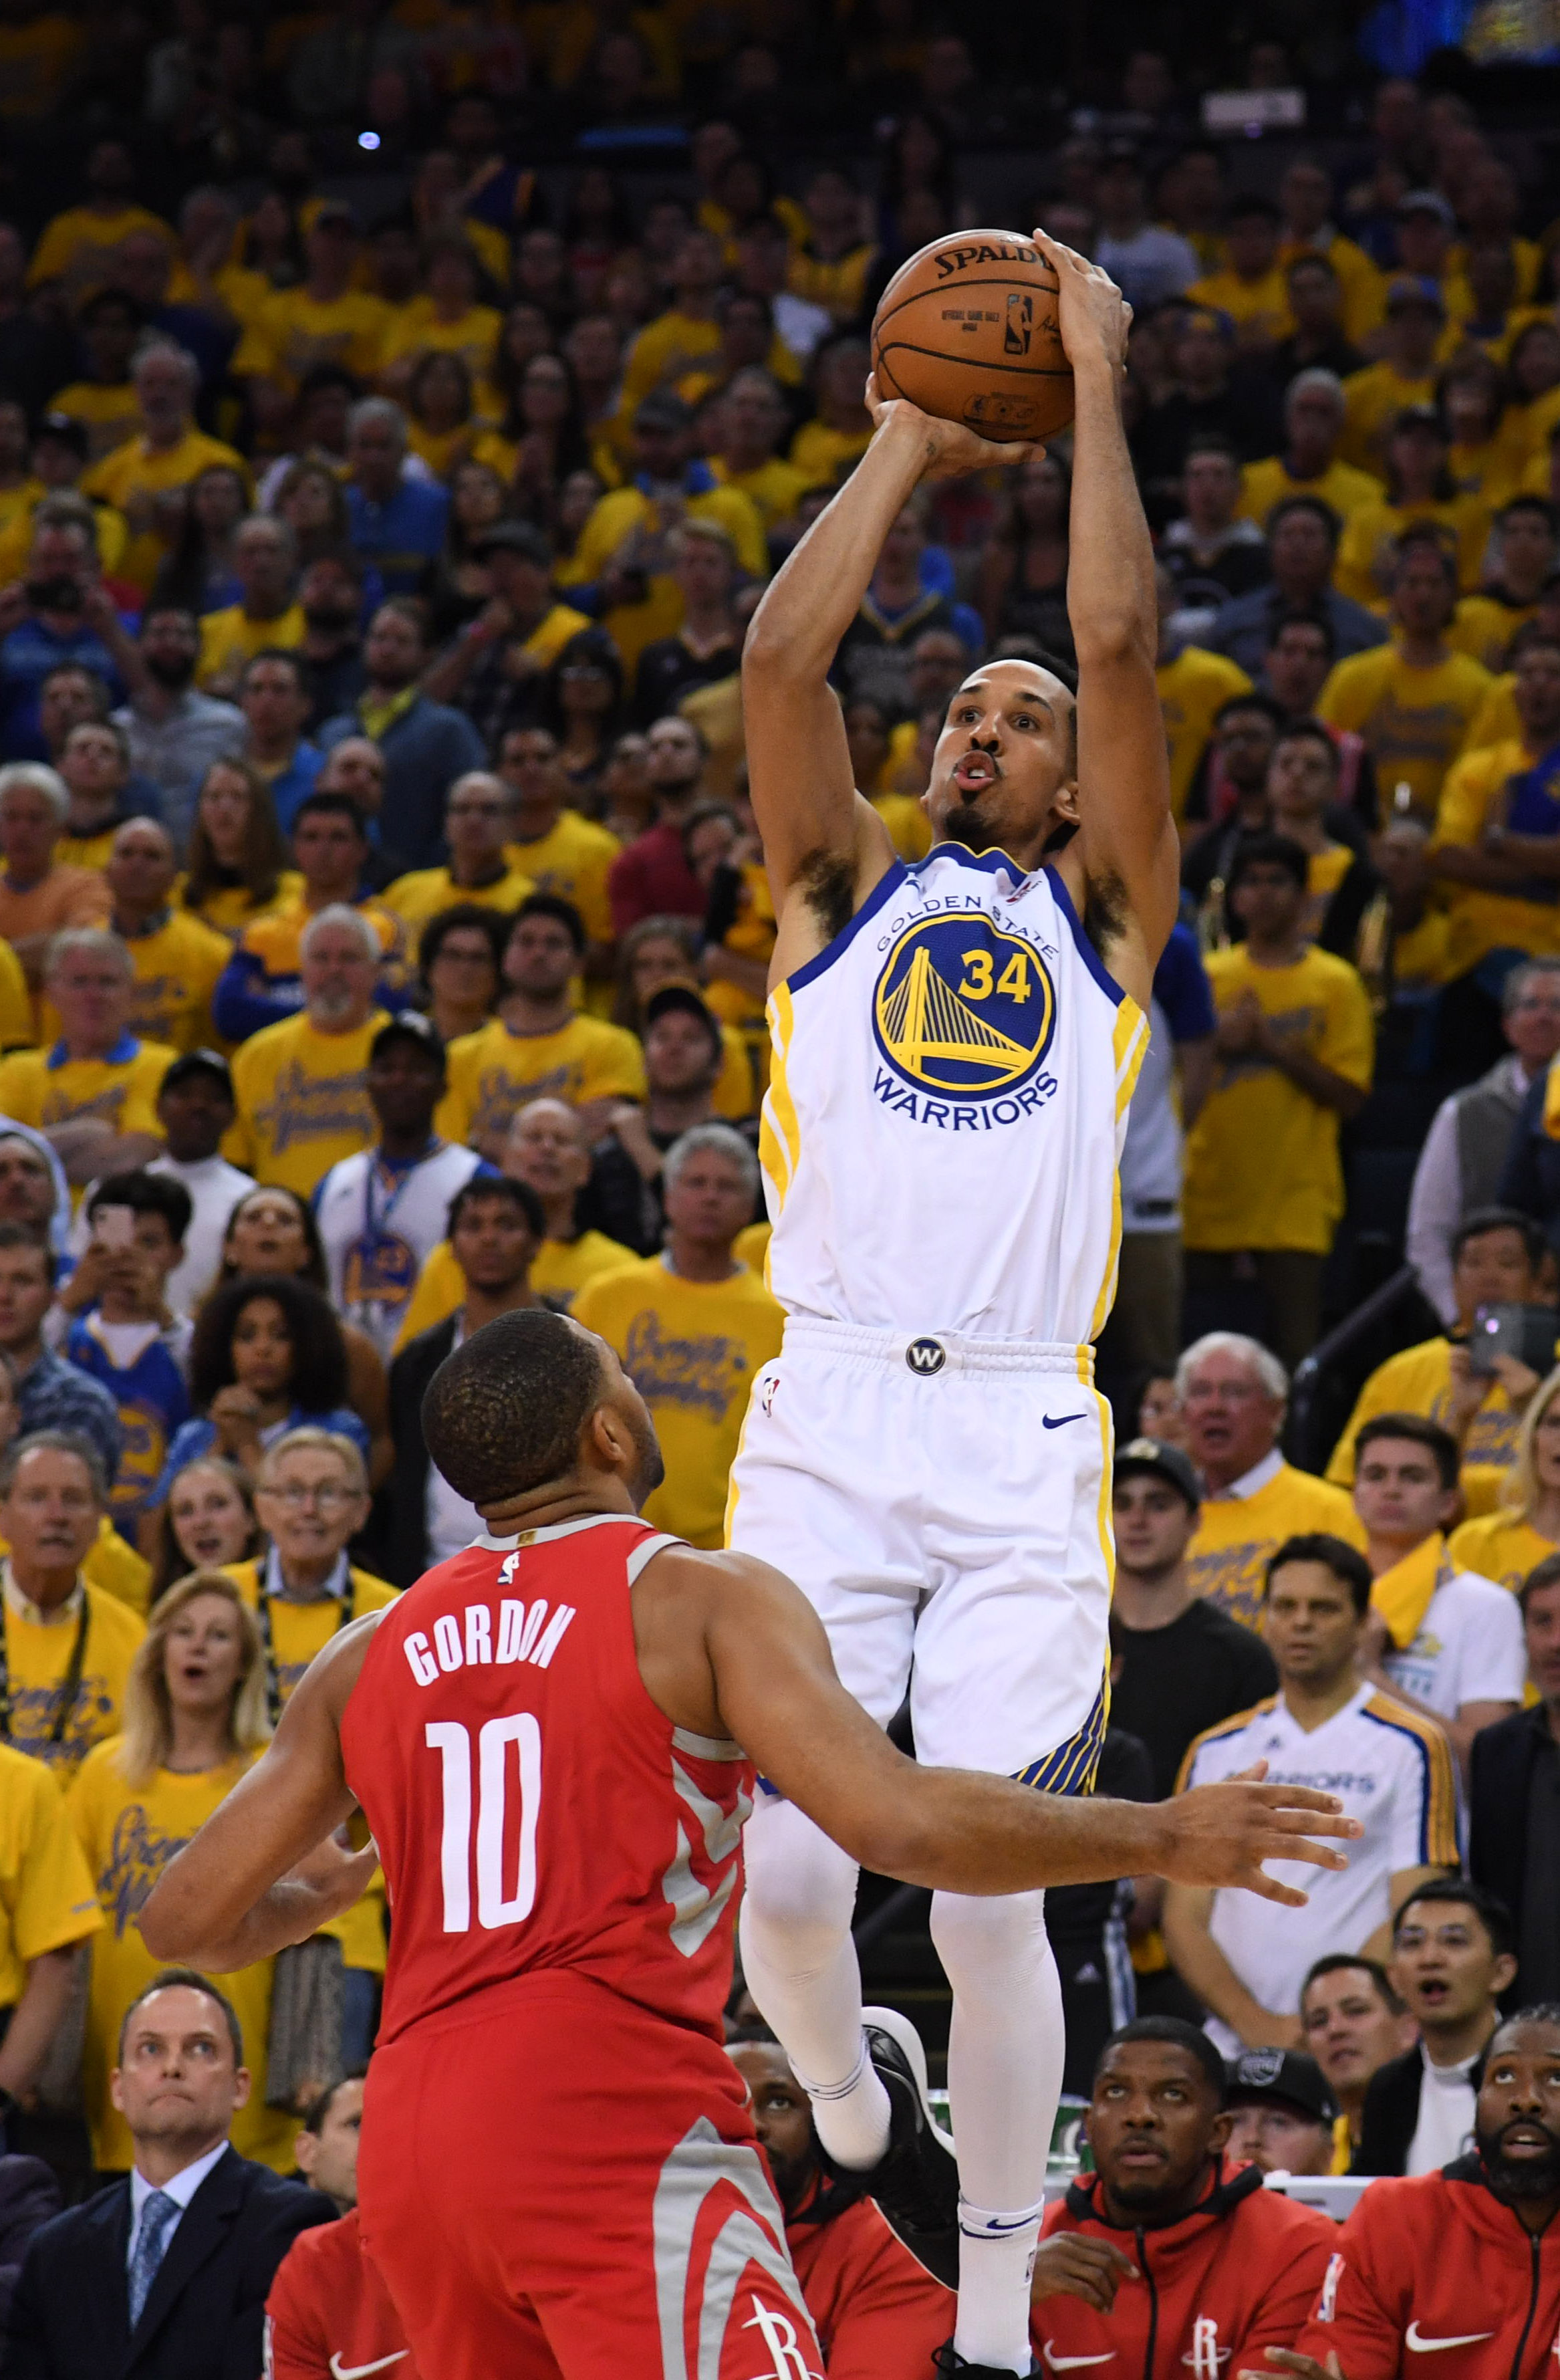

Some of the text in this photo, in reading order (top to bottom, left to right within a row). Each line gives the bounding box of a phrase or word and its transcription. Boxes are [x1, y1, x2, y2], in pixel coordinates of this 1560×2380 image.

[877, 895, 1059, 961] GOLDEN STATE
[958, 948, 1031, 1004] 34
[873, 1066, 1059, 1131] WARRIORS
[911, 1345, 942, 1368] W
[403, 1598, 576, 1687] GORDON
[425, 1712, 541, 1933] 10
